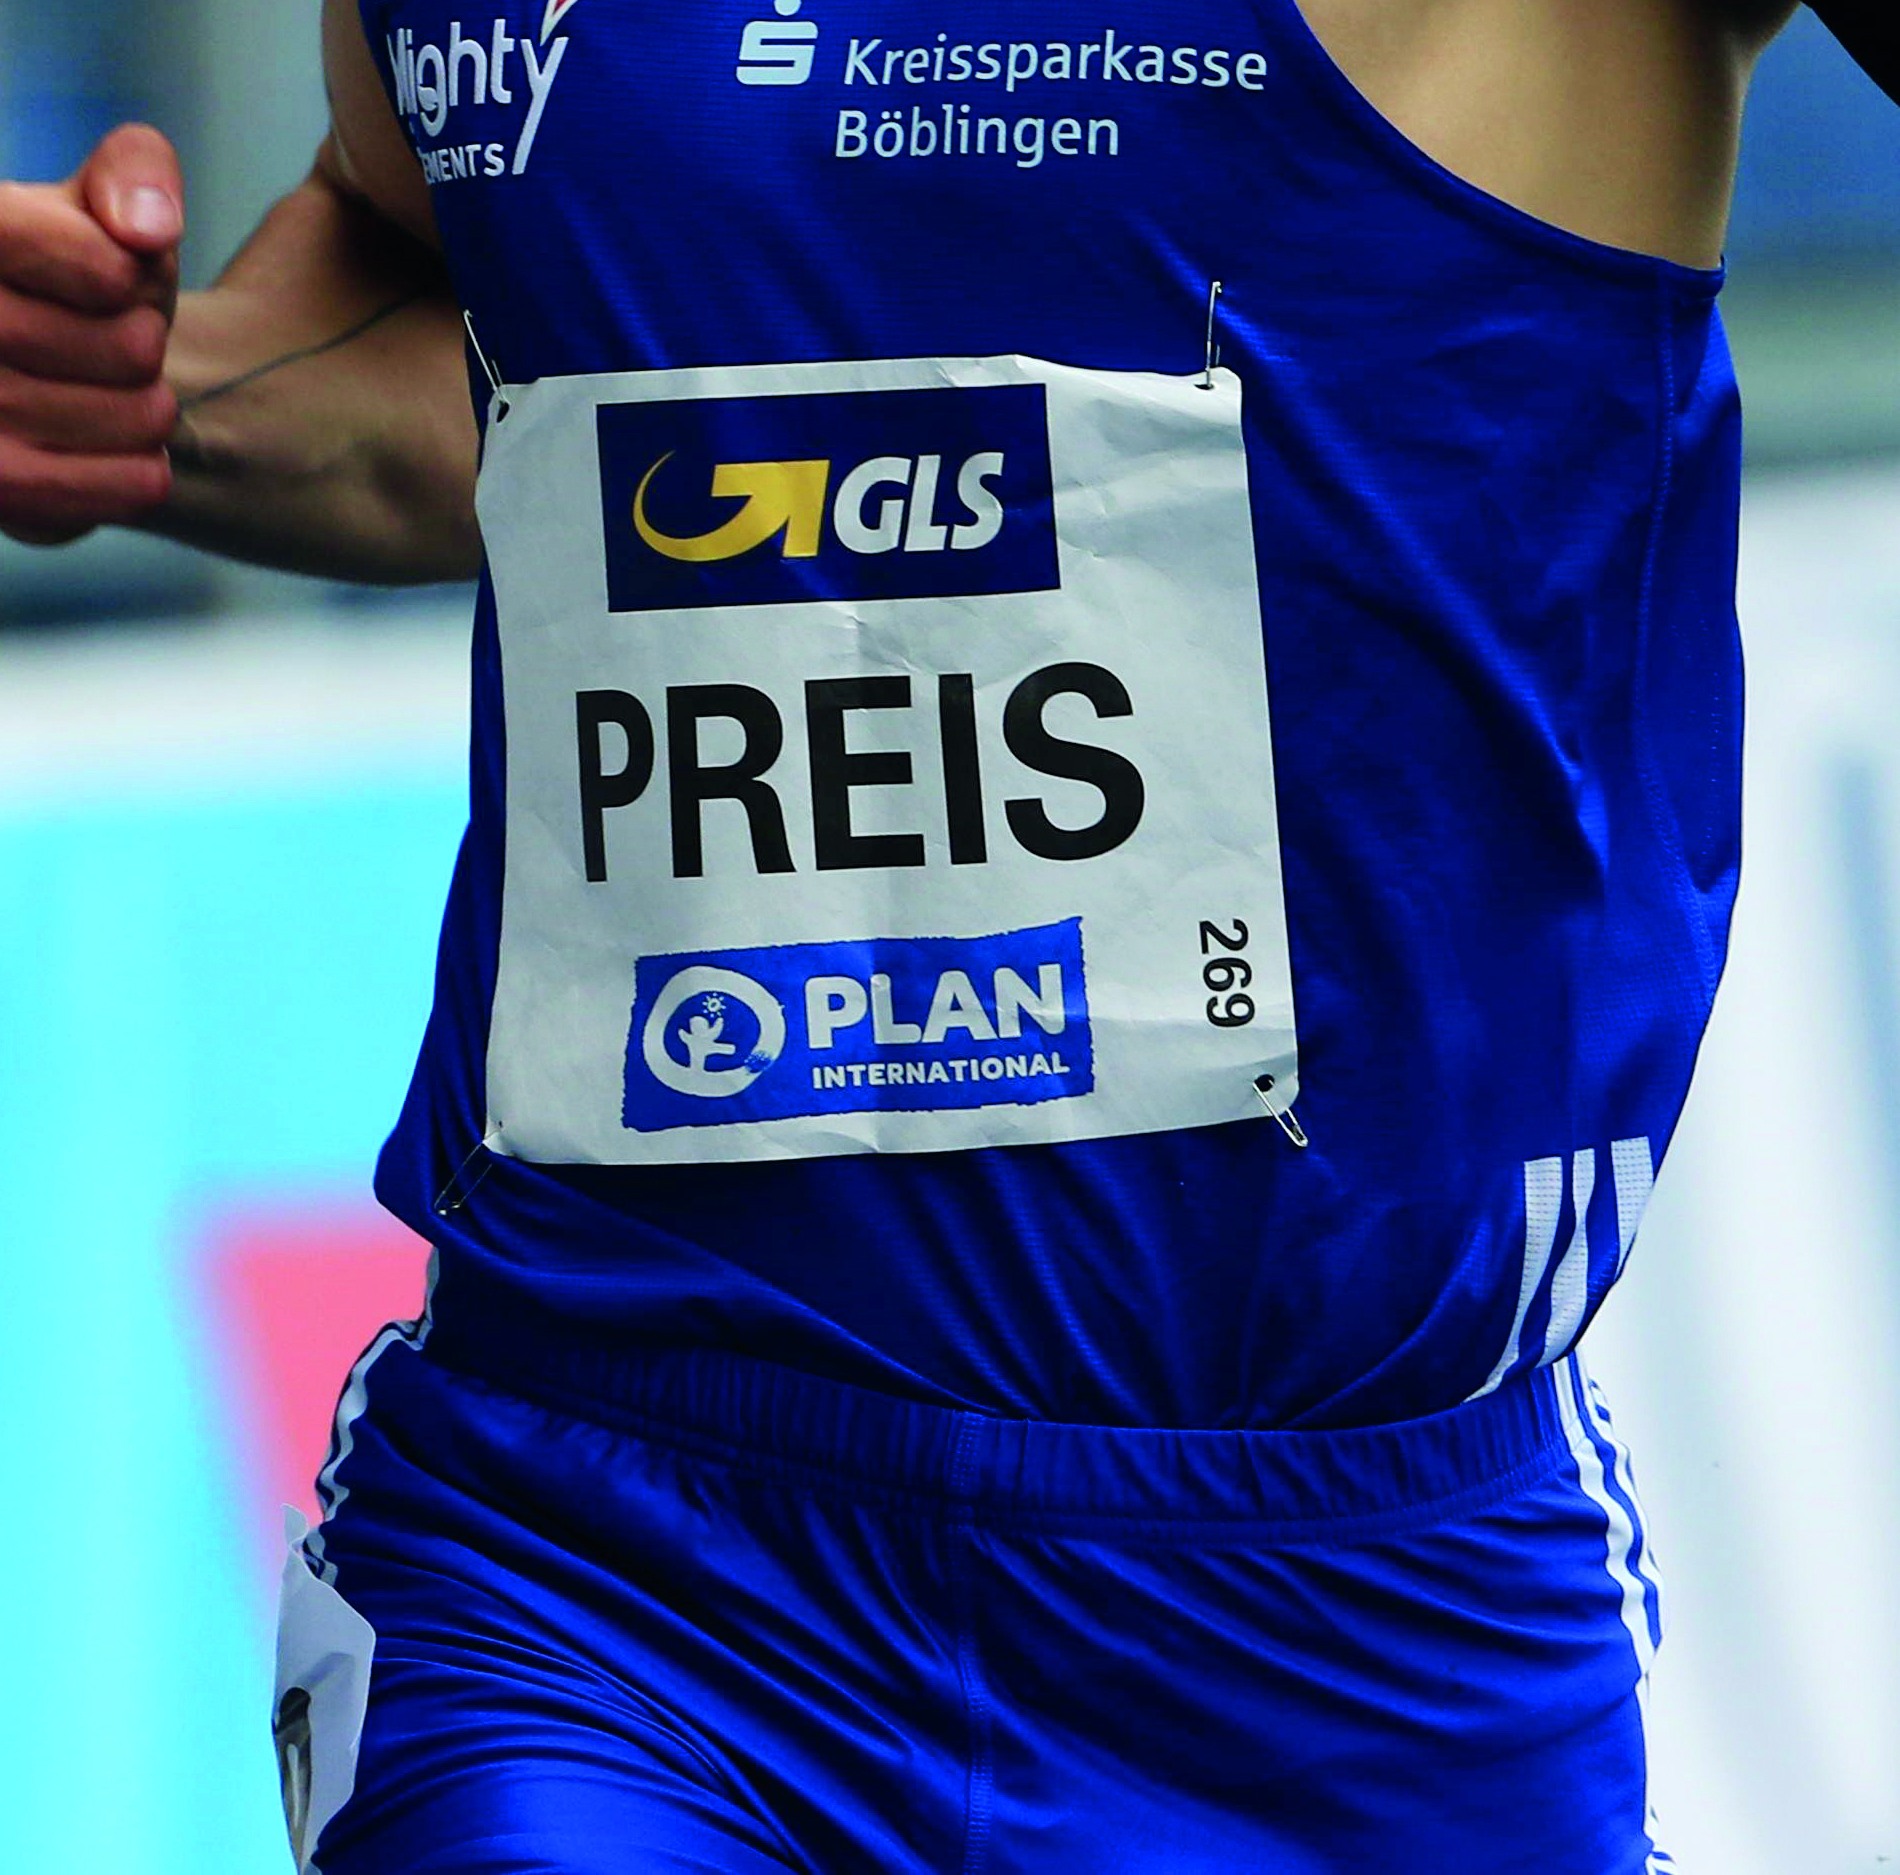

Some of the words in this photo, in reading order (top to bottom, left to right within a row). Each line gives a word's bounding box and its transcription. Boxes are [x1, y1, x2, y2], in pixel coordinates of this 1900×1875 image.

[843, 29, 1268, 92] Kreissparkasse
[835, 103, 1119, 168] Böblingen
[834, 451, 1005, 555] GLS
[575, 661, 1146, 884] PREIS
[805, 963, 1066, 1049] PLAN
[1199, 918, 1255, 1027] 269
[812, 1051, 1071, 1089] INTERNATIONAL
